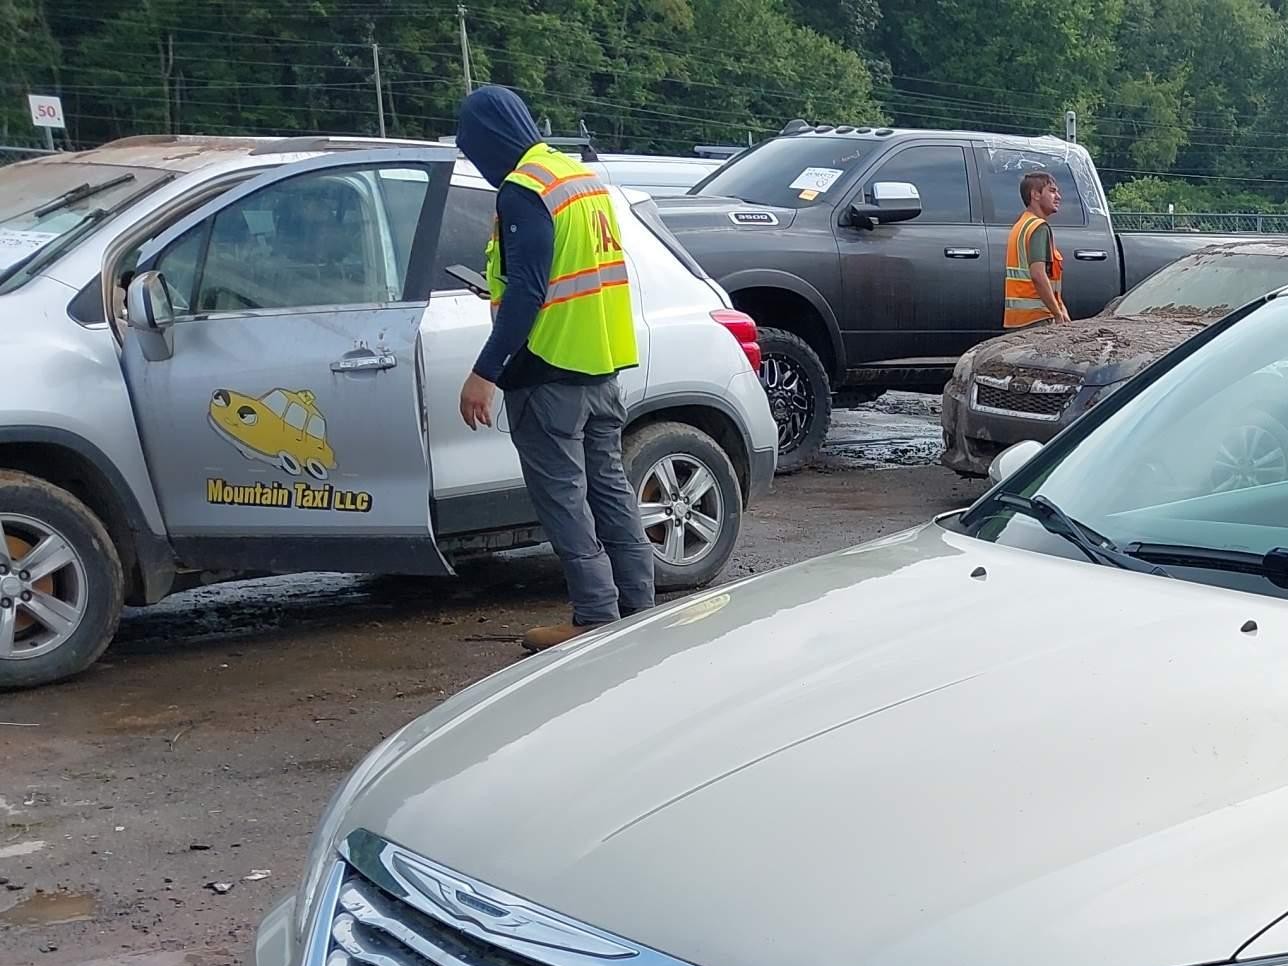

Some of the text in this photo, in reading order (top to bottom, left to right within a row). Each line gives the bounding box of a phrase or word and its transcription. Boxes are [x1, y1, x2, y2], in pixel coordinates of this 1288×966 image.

[37, 105, 57, 118] 50
[737, 213, 769, 221] 3500
[207, 479, 372, 511] Mountain Taxi LLC
